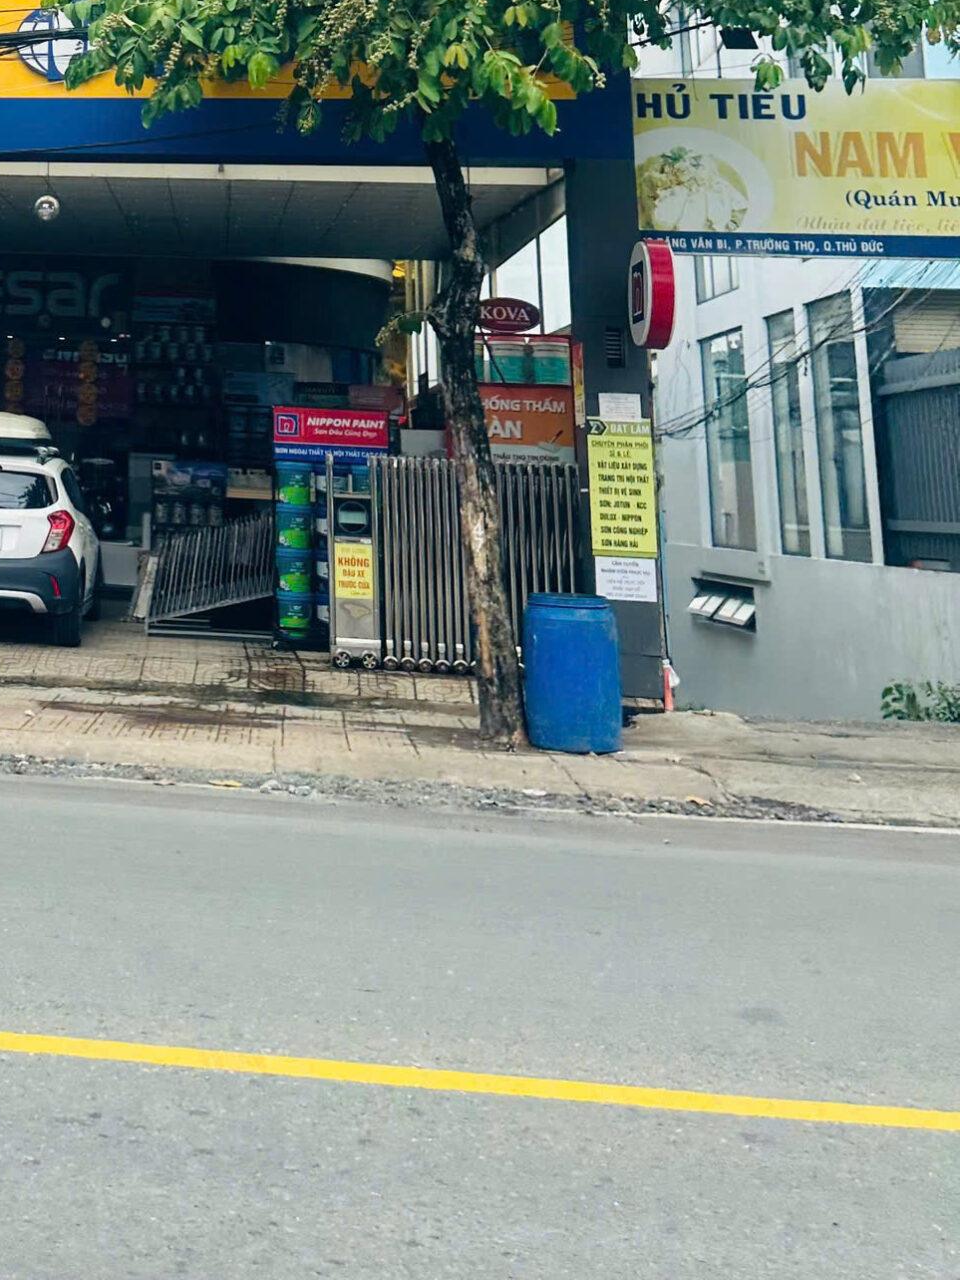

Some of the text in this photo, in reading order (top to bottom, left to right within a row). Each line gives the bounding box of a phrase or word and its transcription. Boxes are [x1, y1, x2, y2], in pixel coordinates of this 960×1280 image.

[637, 83, 691, 119] HỦ
[794, 131, 928, 179] NAM
[845, 189, 960, 209] (Quán Mu
[480, 305, 530, 321] KOVA
[481, 394, 521, 412] HỐNG
[307, 417, 386, 429] NIPPON PAINT
[486, 415, 523, 439] ÀN
[338, 555, 370, 568] KHÔNG
